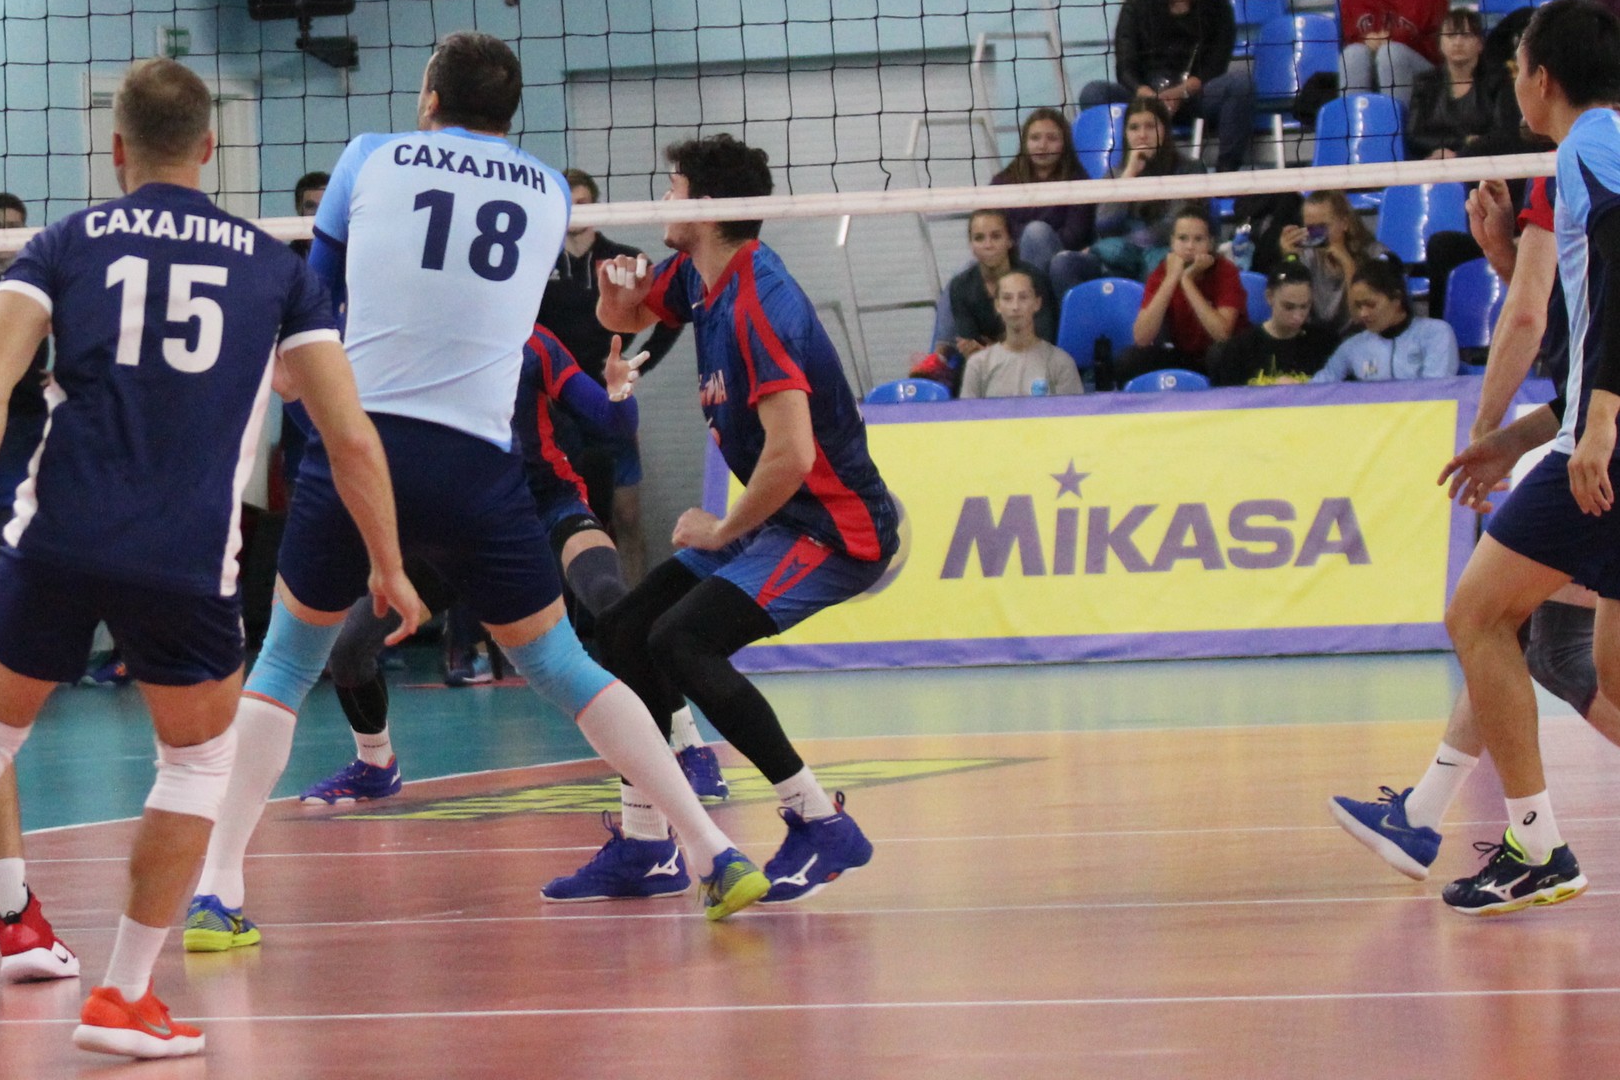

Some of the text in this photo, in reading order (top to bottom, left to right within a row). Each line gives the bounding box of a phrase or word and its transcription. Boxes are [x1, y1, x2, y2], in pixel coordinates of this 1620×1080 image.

[394, 144, 546, 194] САХАЛИН
[85, 208, 255, 256] САХАЛИН
[413, 188, 528, 282] 18
[105, 254, 229, 374] 15
